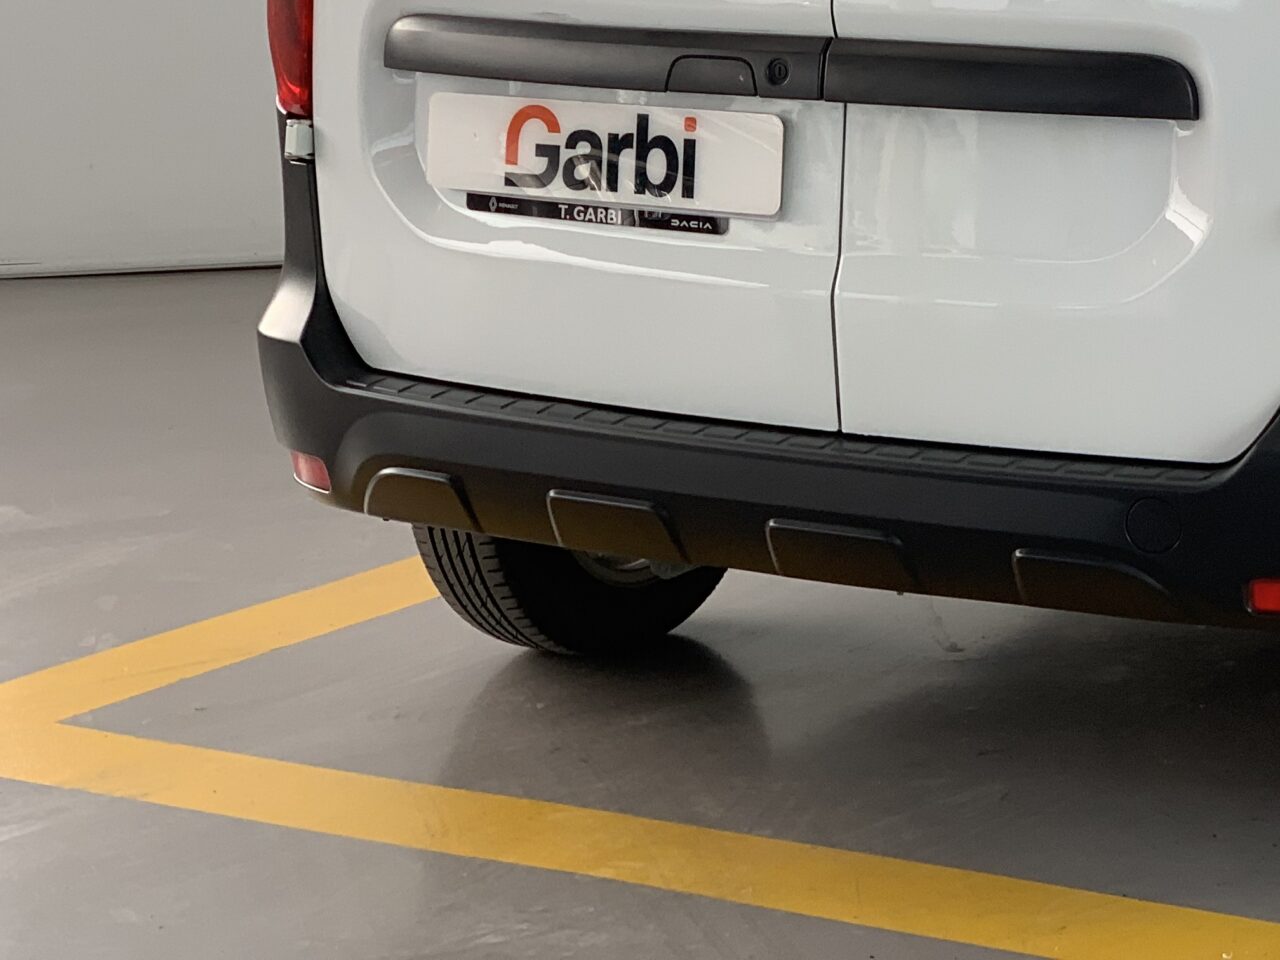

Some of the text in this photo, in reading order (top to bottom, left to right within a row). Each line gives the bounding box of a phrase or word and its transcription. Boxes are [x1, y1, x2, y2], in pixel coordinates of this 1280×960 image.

[504, 104, 697, 199] Garbi
[558, 204, 621, 223] T. GARBI
[671, 219, 712, 230] DACIA
